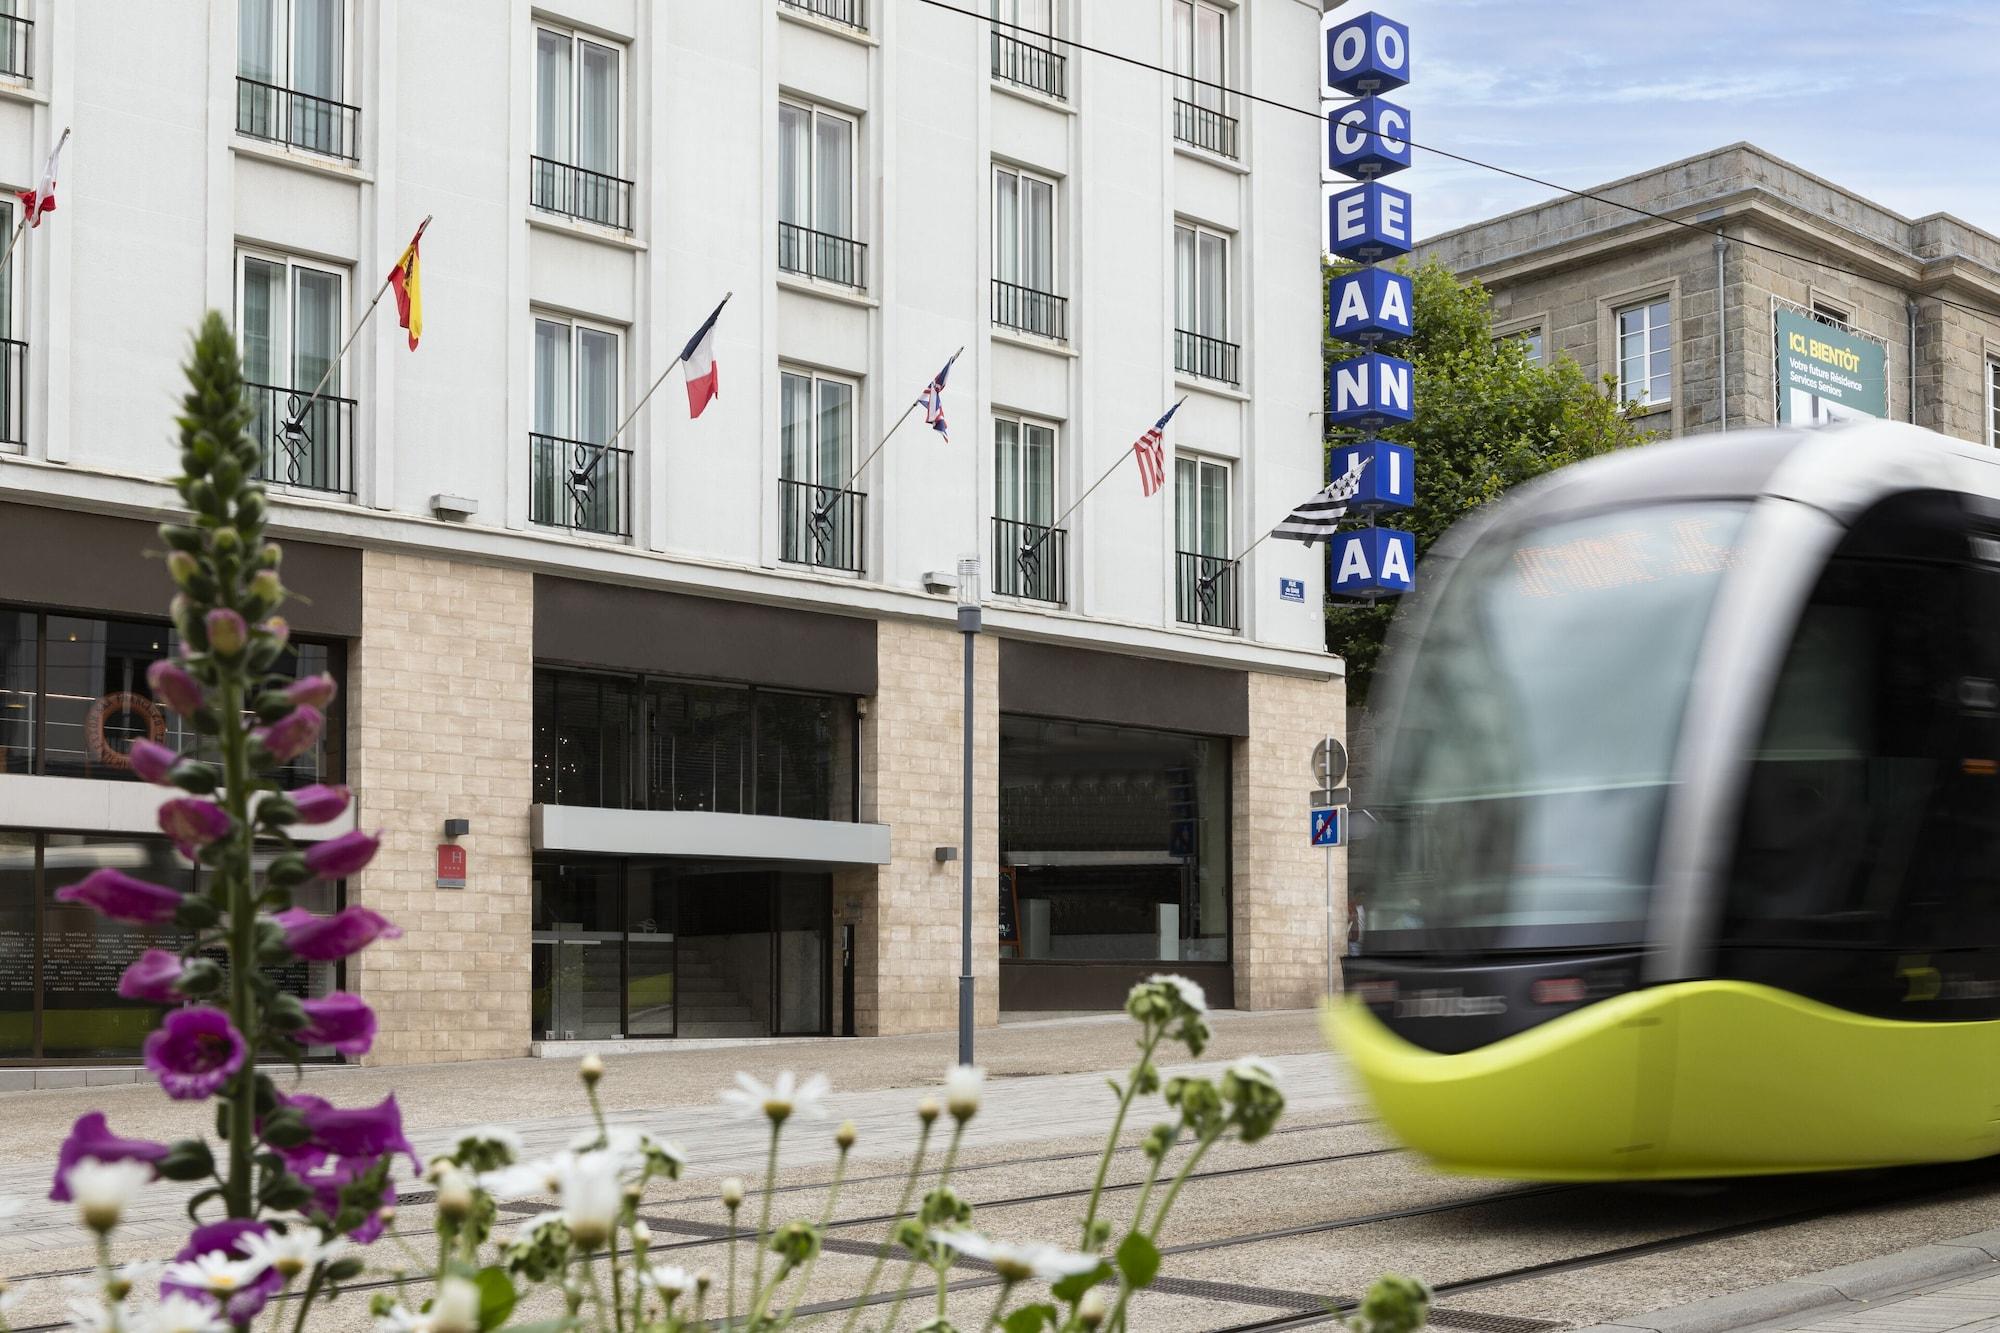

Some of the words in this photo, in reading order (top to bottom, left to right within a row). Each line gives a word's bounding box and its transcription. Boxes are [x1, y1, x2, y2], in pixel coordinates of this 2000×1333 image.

[1376, 25, 1410, 583] OCEANIA
[1789, 331, 1808, 357] ICI,
[1810, 339, 1860, 373] BIENTÔT
[1789, 357, 1809, 373] Votre
[1809, 363, 1830, 380] future
[1830, 371, 1863, 392] Résidence
[1790, 371, 1818, 389] Services
[1818, 381, 1842, 397] Seniors
